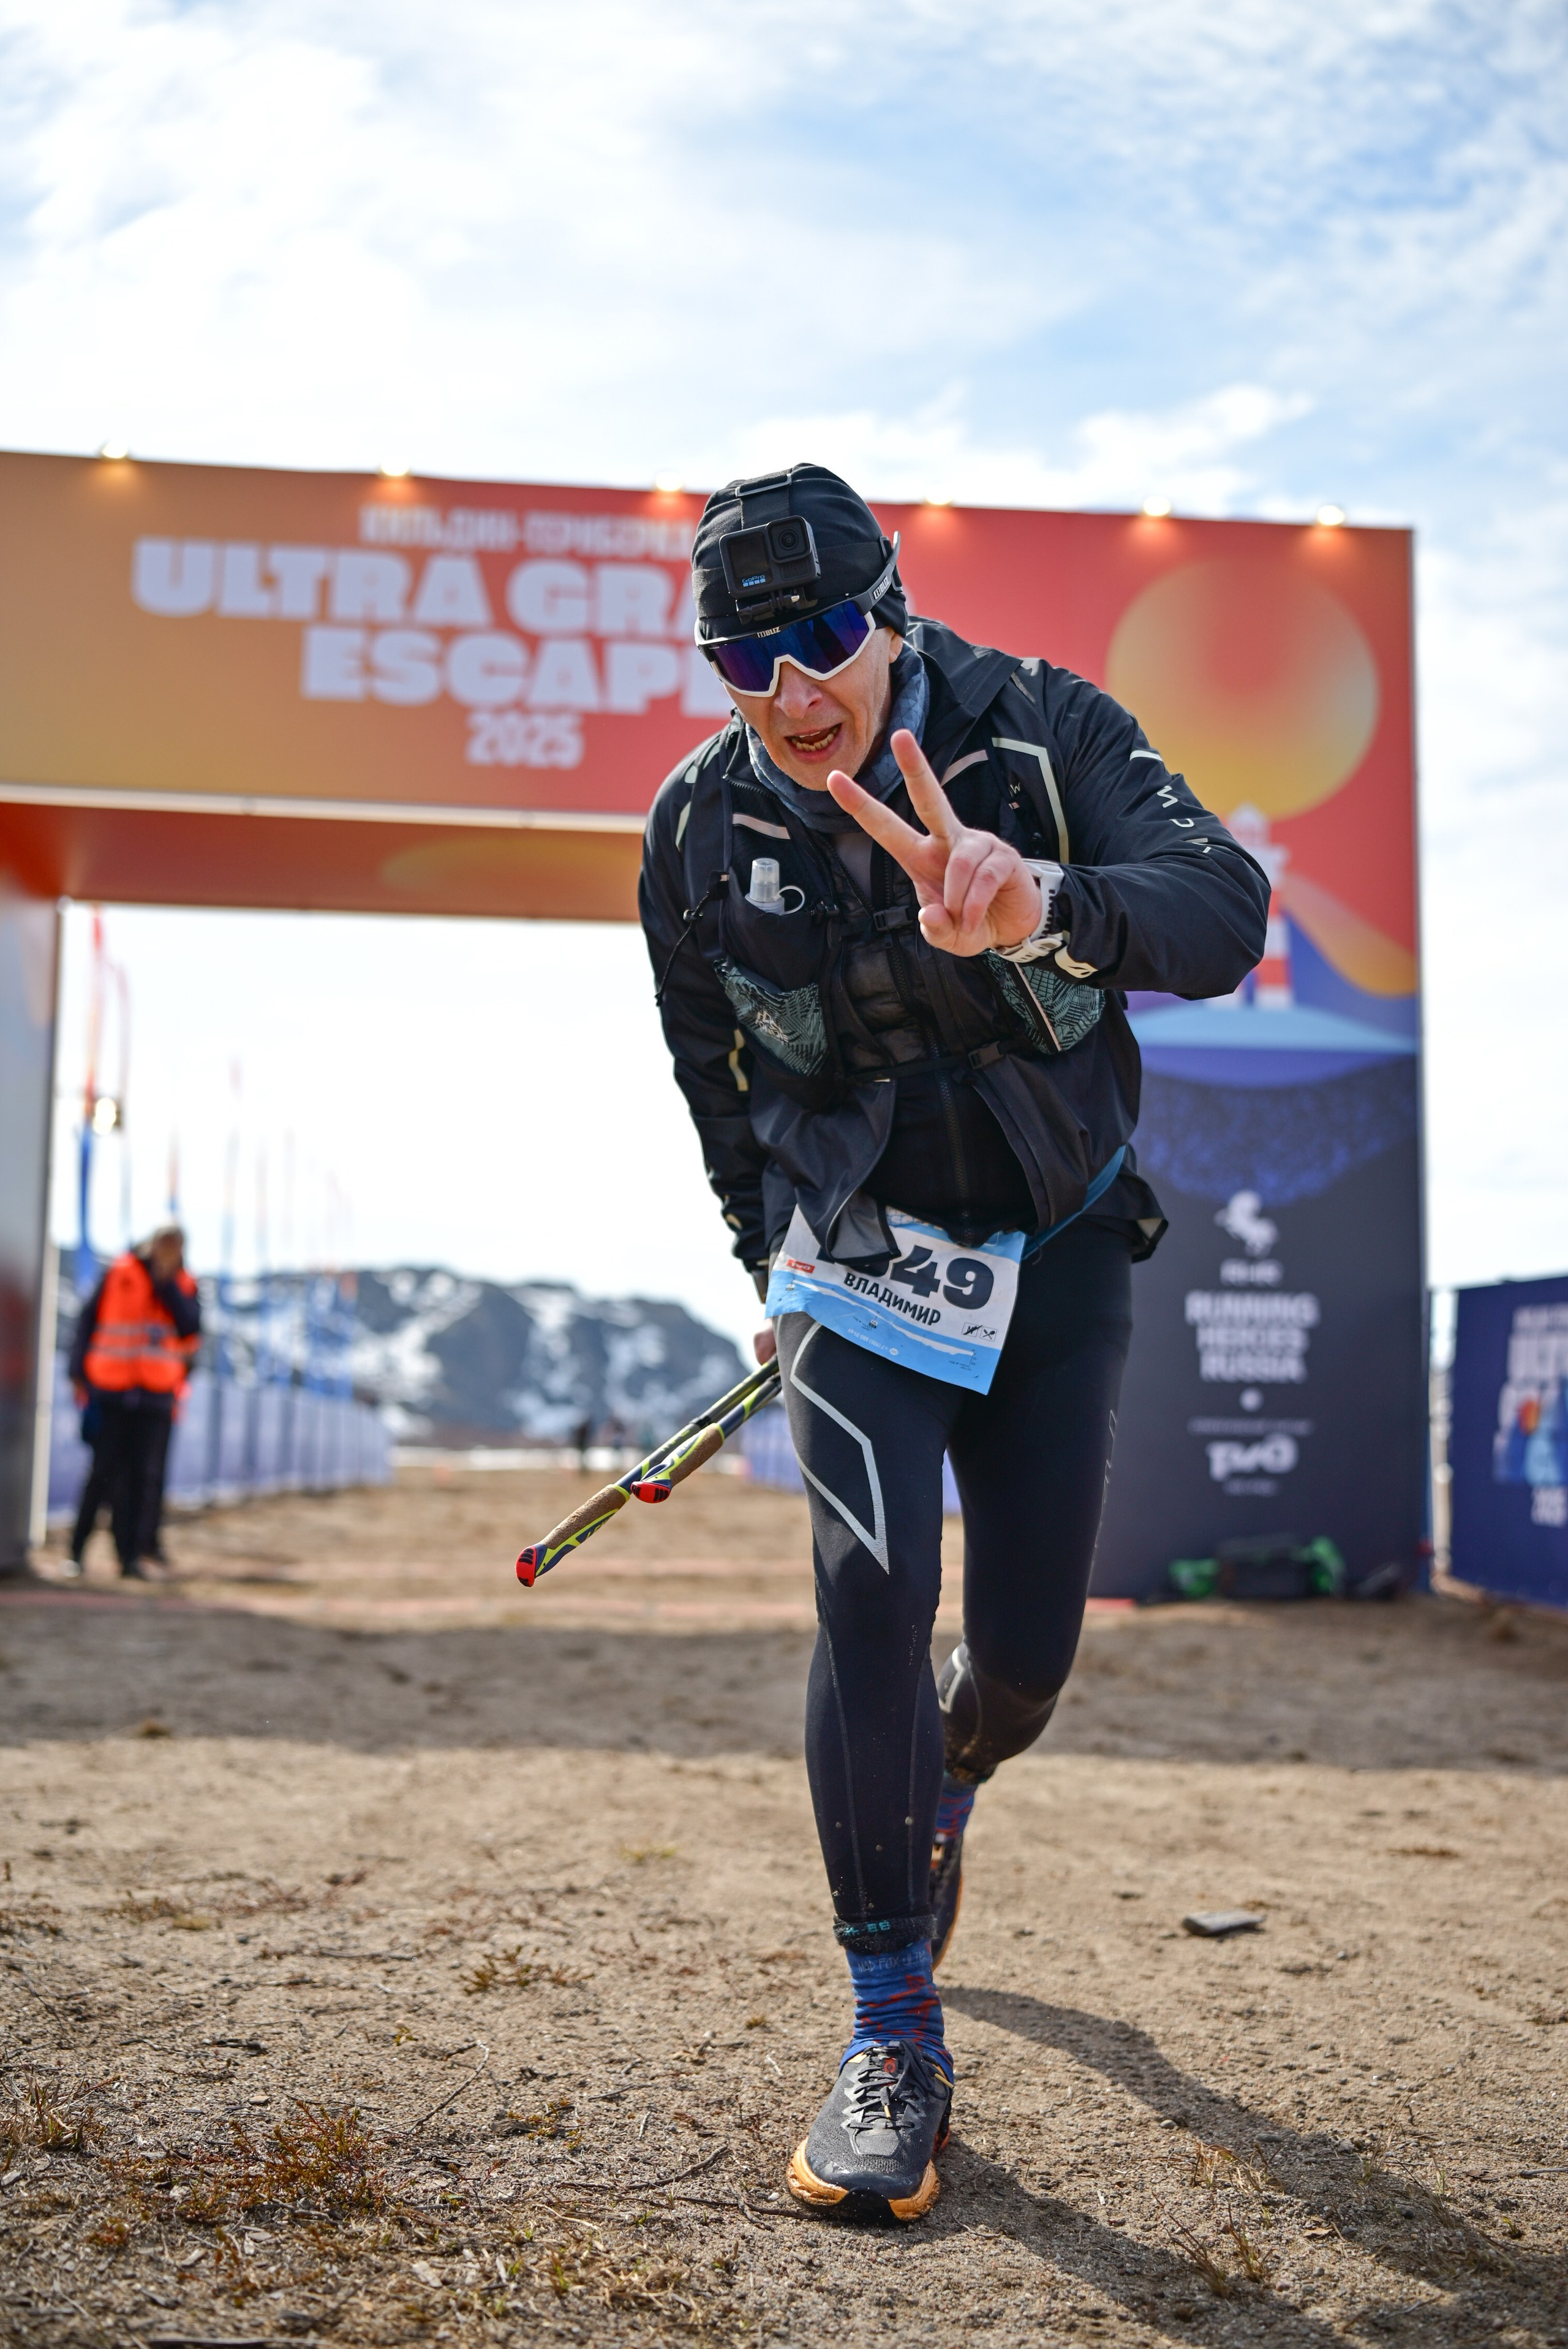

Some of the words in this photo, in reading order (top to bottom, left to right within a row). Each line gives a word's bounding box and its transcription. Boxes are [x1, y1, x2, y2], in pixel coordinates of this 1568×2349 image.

[132, 537, 492, 628] ULTRA
[508, 558, 696, 638] GR
[466, 709, 583, 768] 2025
[816, 1244, 993, 1309] 49
[844, 1272, 940, 1326] ВЛАДИМИР
